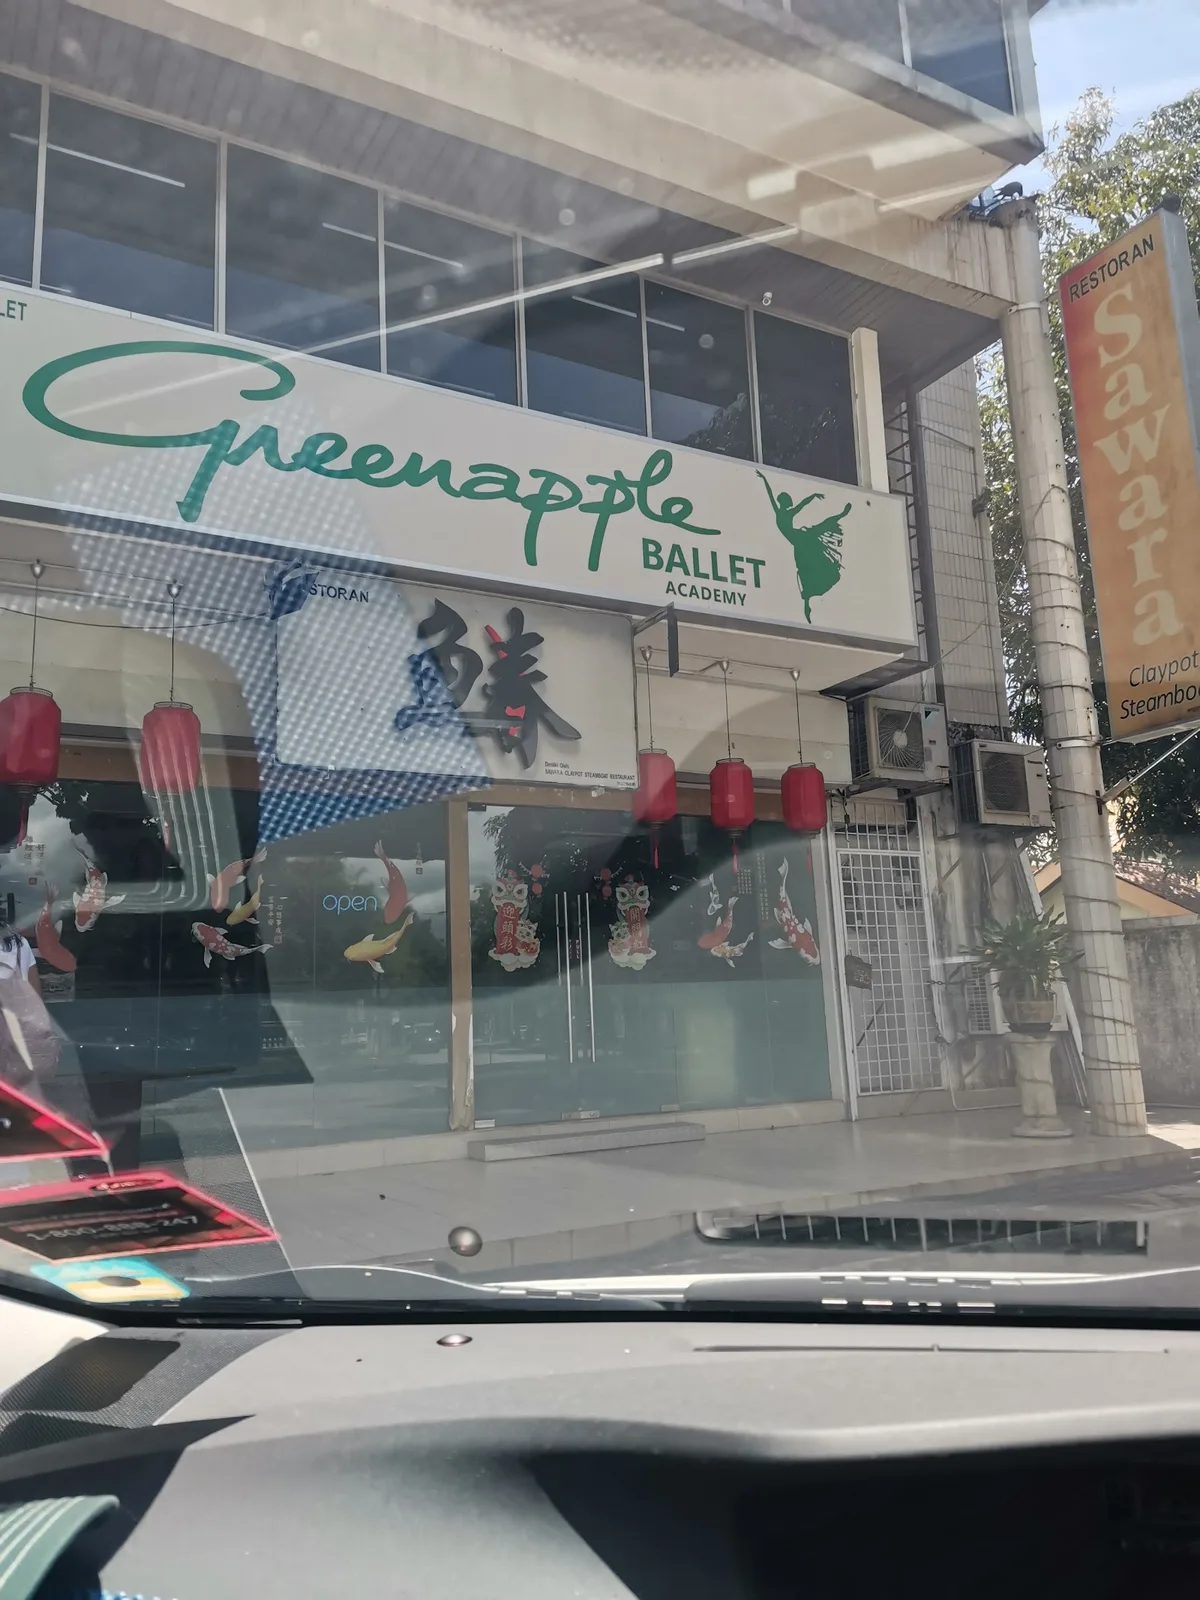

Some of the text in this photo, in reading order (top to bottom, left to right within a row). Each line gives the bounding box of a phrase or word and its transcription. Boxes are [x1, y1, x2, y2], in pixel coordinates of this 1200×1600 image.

[1069, 234, 1155, 303] RESTORAN
[22, 340, 722, 572] Greenapple
[641, 537, 766, 588] BALLET
[310, 583, 369, 603] STORAN
[665, 580, 747, 607] ACADEMY
[1129, 650, 1200, 687] Claypot
[1120, 684, 1200, 720] Steambo
[322, 894, 378, 915] open
